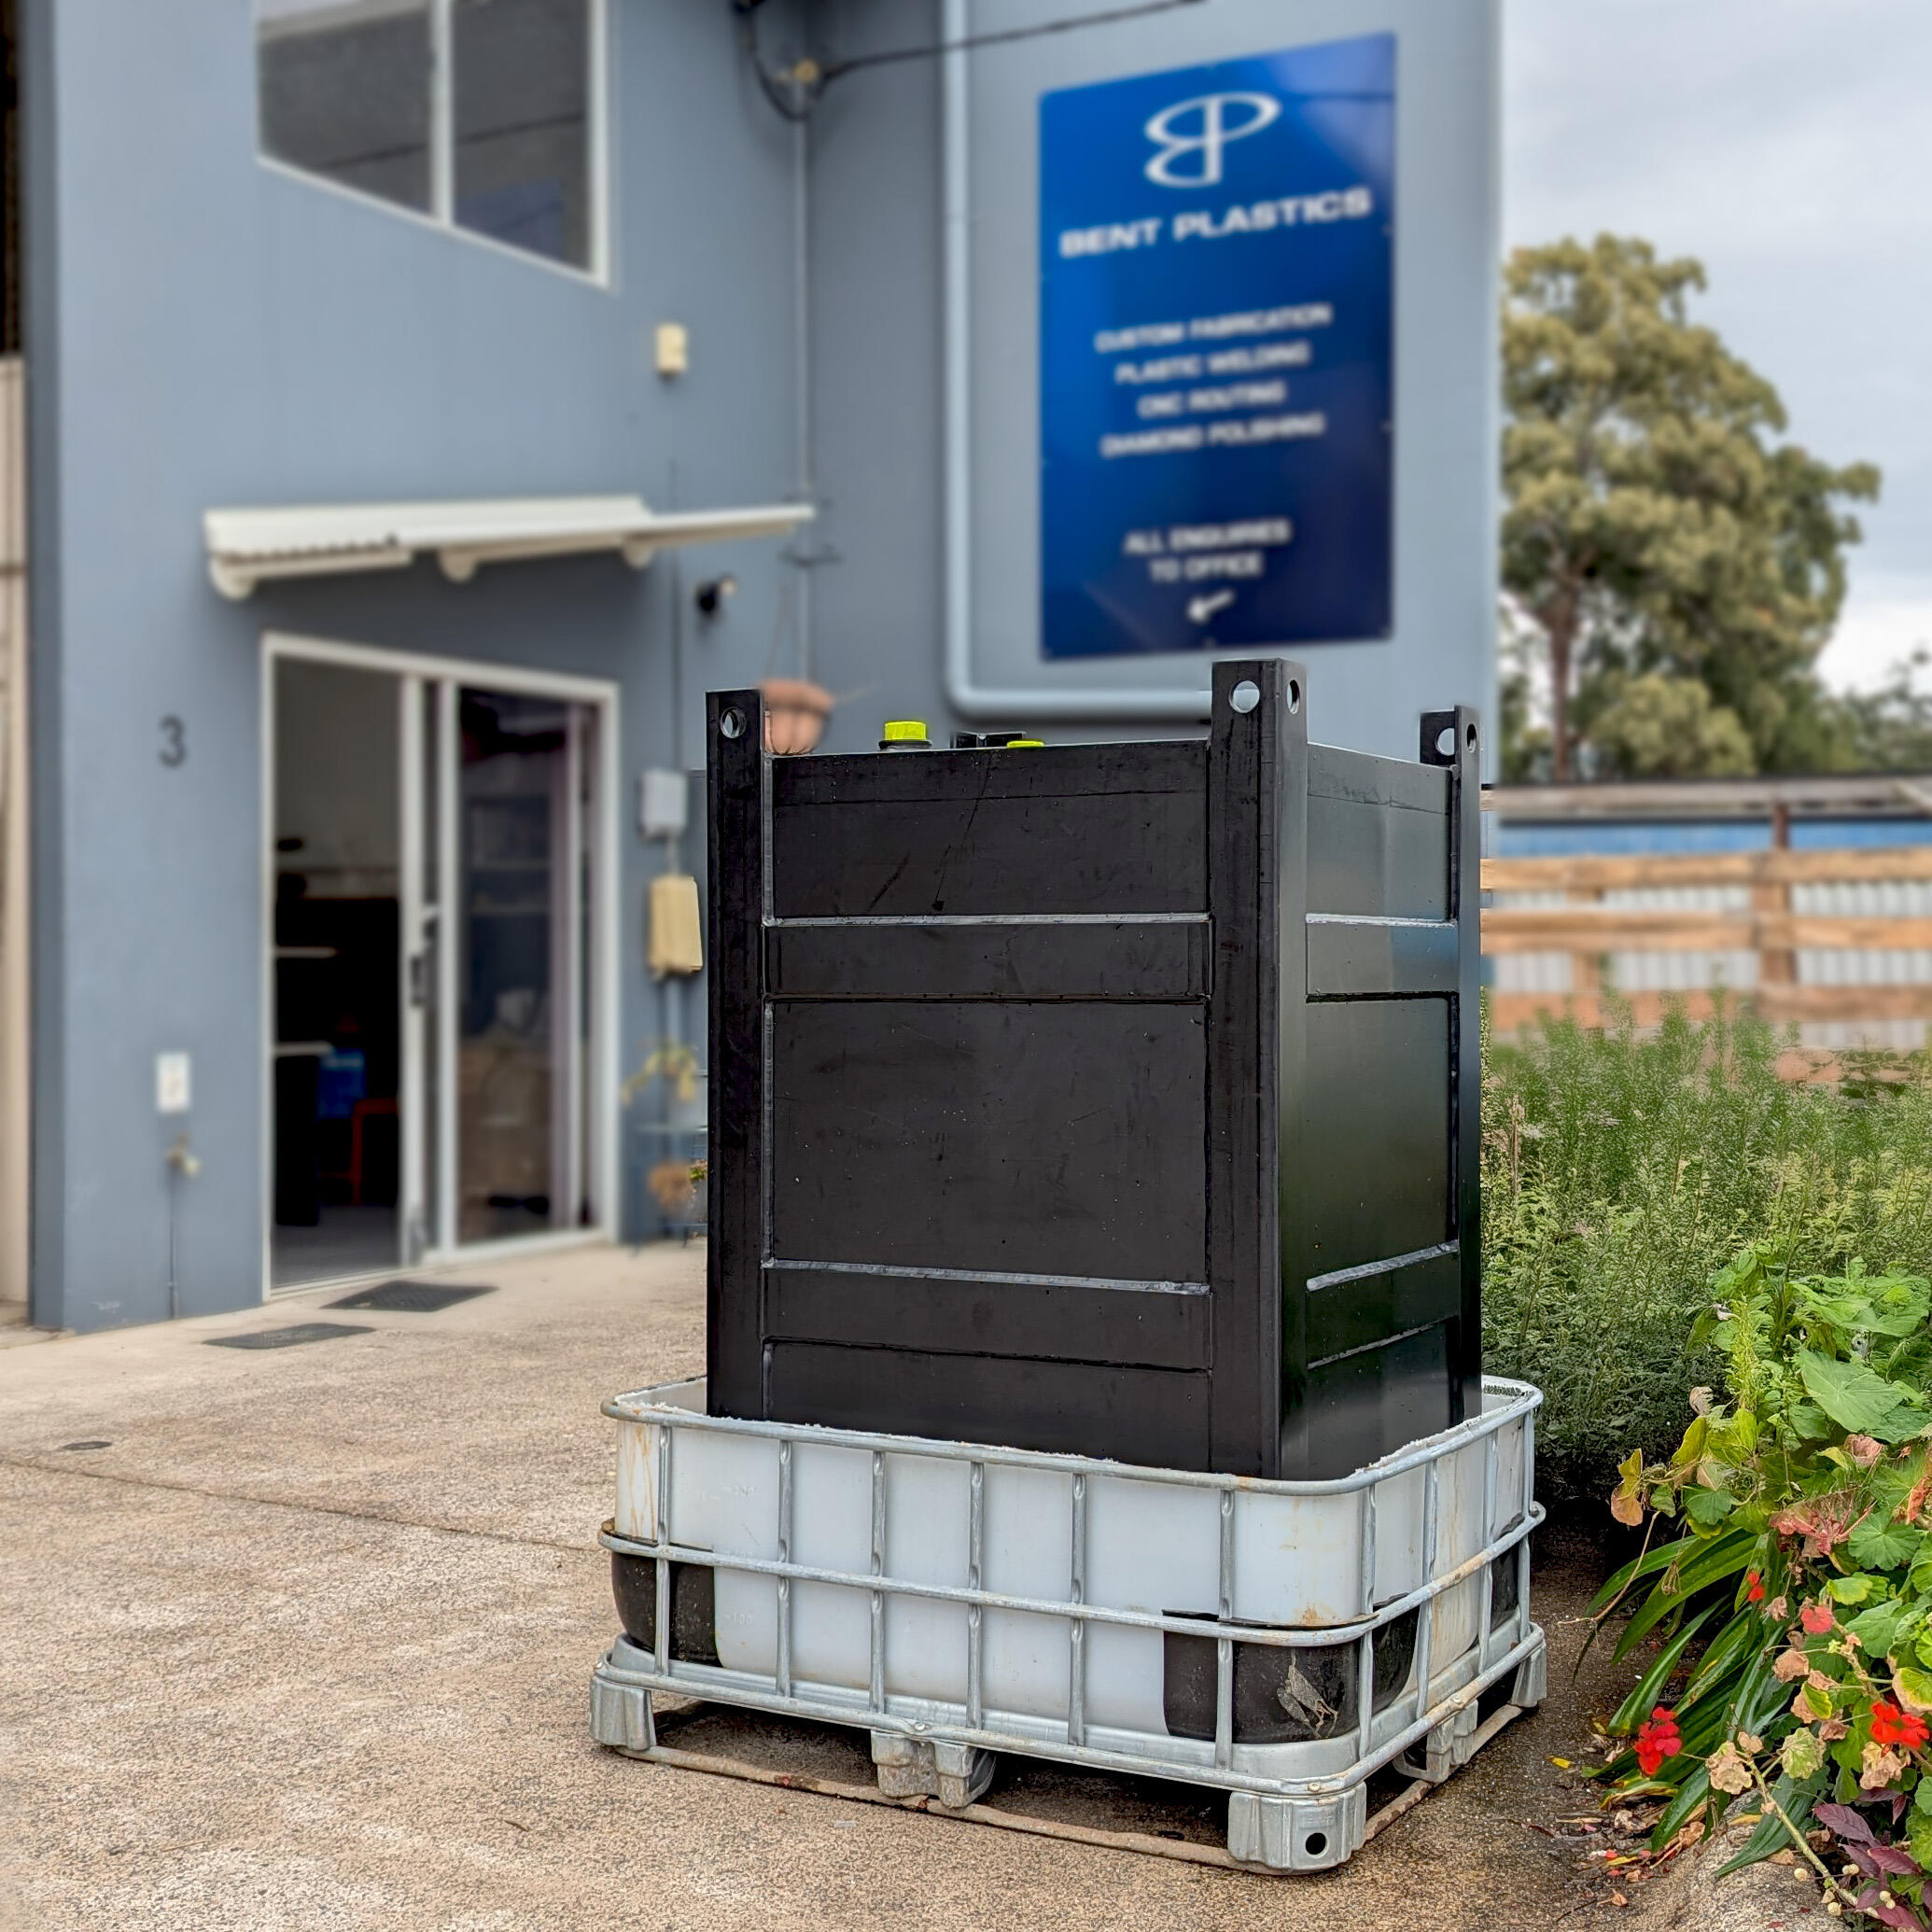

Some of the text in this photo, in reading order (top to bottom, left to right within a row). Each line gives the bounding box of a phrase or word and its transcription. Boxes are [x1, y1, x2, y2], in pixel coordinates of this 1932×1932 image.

[1059, 189, 1372, 258] BENT PLASTICS
[1095, 304, 1332, 352] CUSTOM FABRICATION
[1115, 342, 1310, 384] PLASTIC WELDING
[1138, 381, 1286, 418] CNC ROUTING
[1100, 413, 1325, 457] DIAMOND POLISHING
[1124, 532, 1163, 554] ALL
[1150, 553, 1262, 581] TO OFFICE
[160, 714, 186, 766] 3
